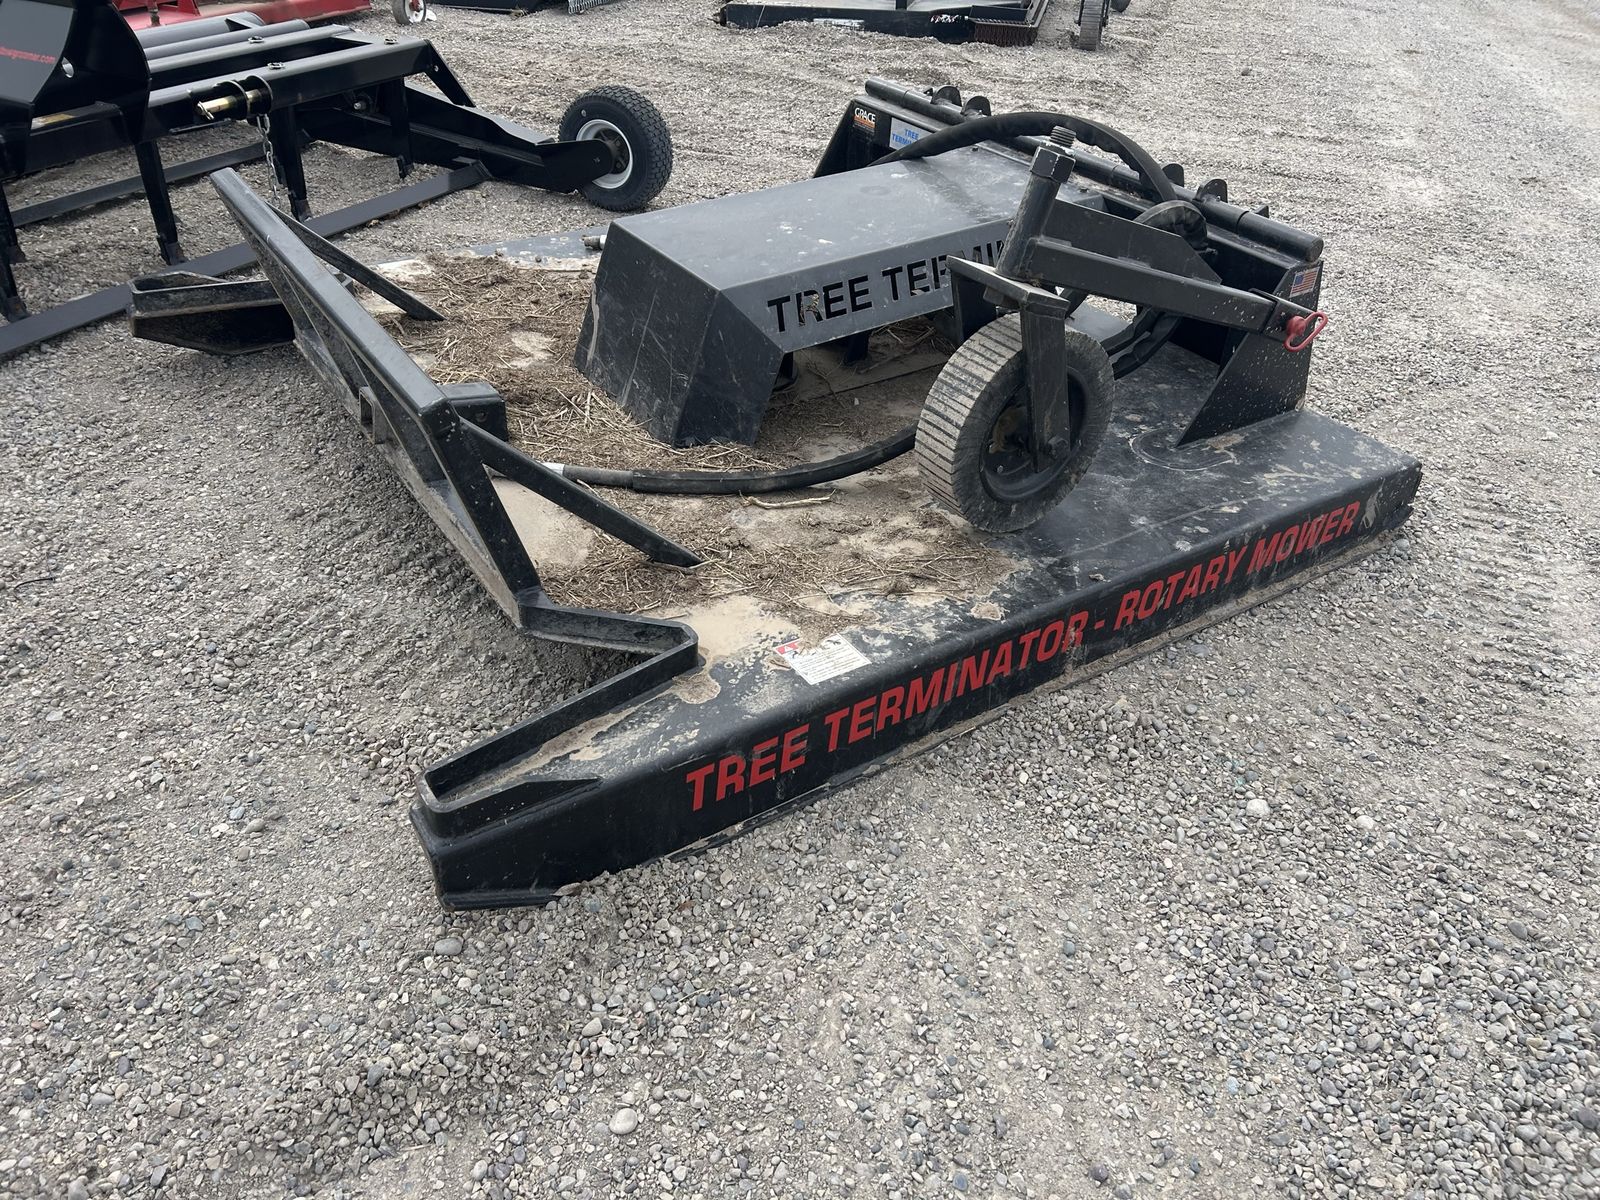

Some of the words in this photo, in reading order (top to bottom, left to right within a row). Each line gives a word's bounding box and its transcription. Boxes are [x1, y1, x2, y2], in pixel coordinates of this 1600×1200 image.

[854, 107, 876, 124] GRACE
[904, 128, 919, 140] TREE
[767, 275, 873, 333] TREE
[686, 724, 810, 812] TREE
[825, 611, 1089, 752] TERMINATOR
[1094, 616, 1110, 630] -
[1113, 546, 1247, 631] ROTARY
[1247, 501, 1360, 574] MOWER
